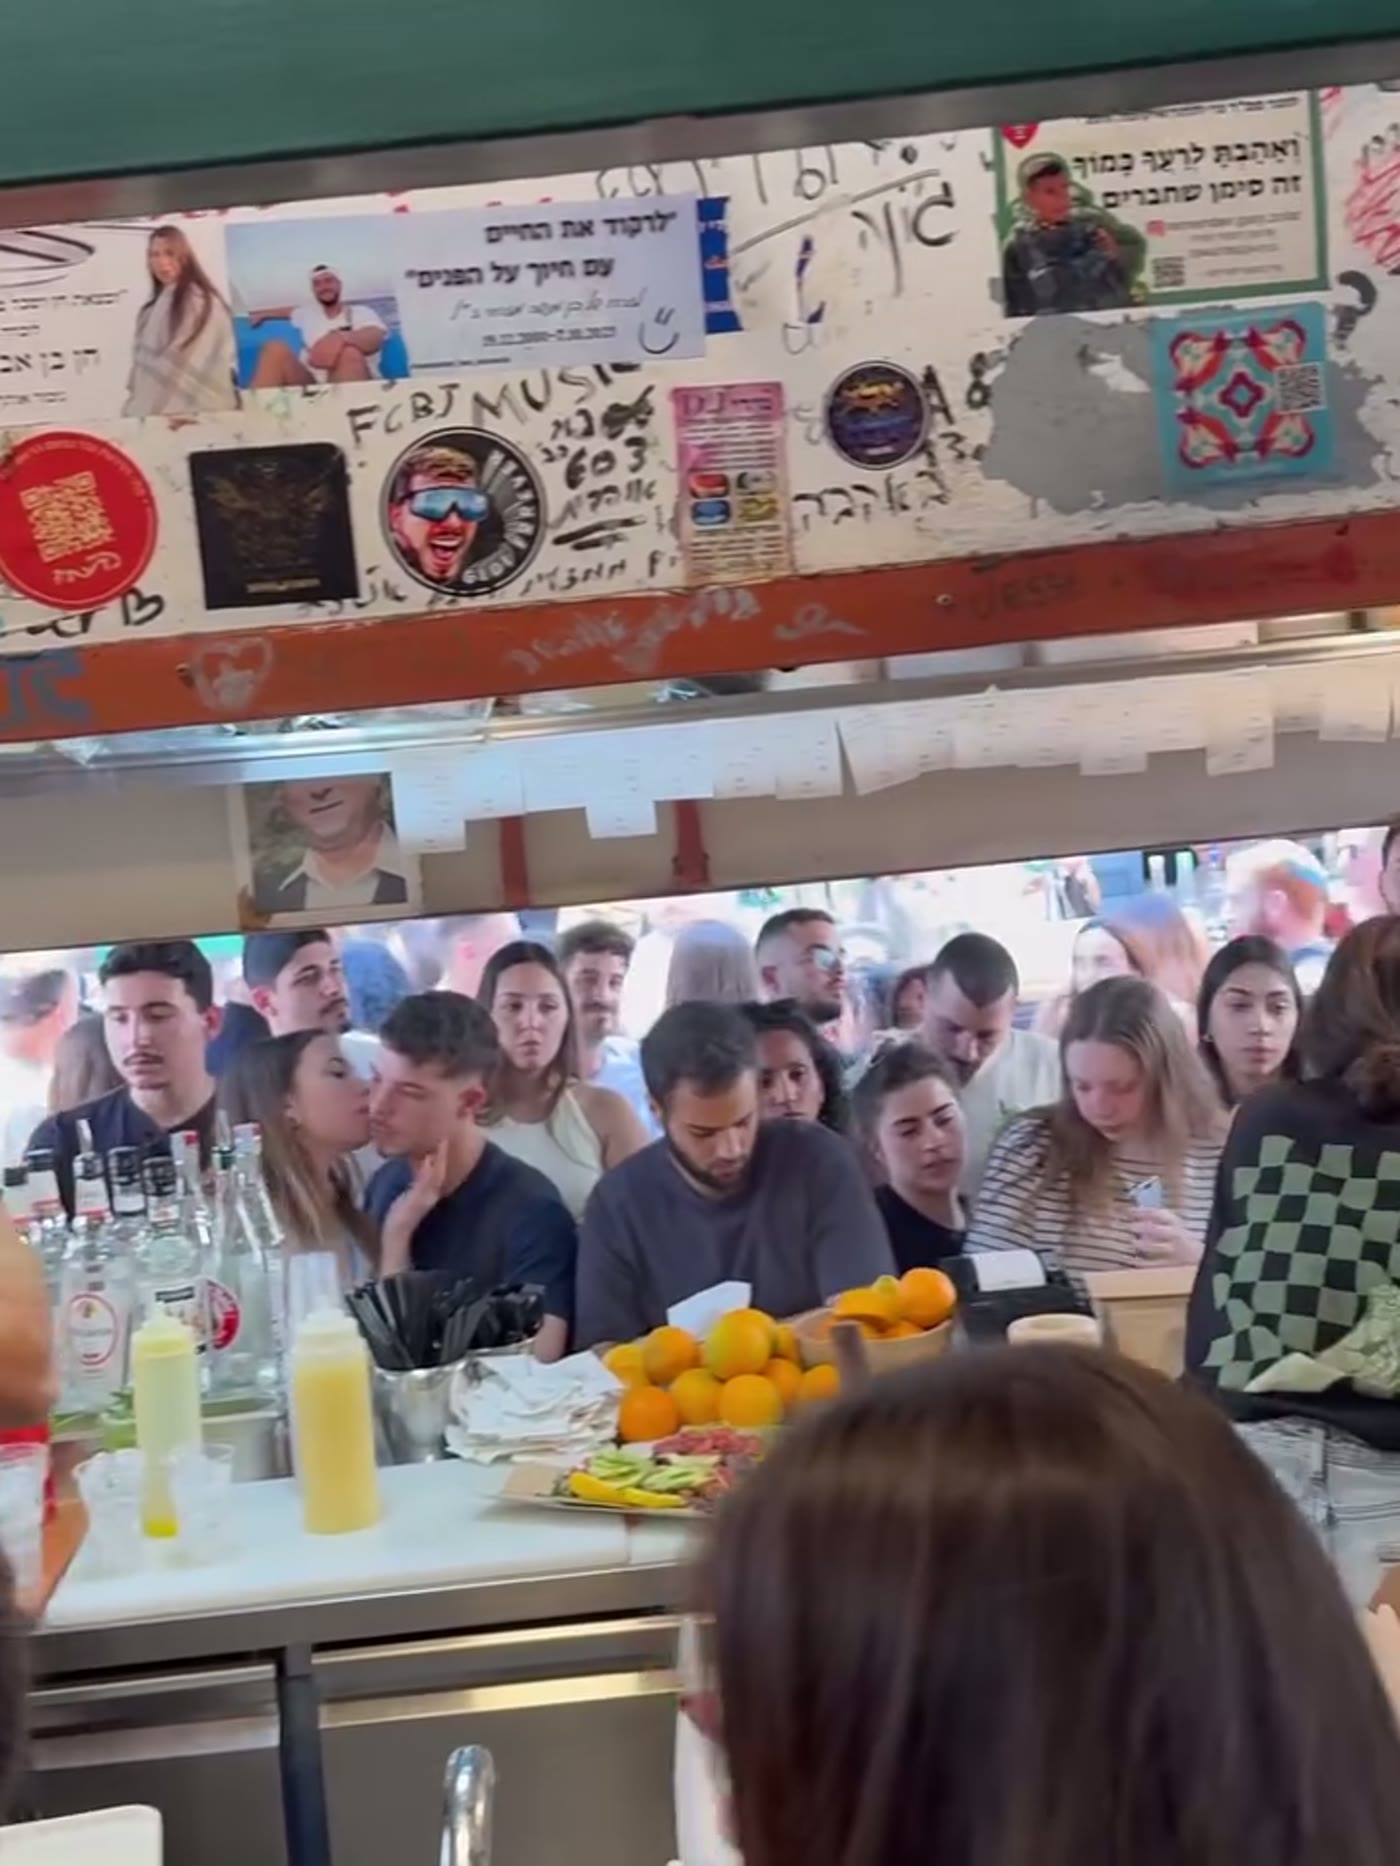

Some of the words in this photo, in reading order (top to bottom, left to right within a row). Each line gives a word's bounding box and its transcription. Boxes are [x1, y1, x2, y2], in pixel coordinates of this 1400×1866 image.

[1209, 178, 1265, 203] סימן
[1271, 175, 1302, 195] זה
[485, 221, 552, 243] החיים
[560, 219, 595, 239] את
[490, 261, 520, 284] על
[526, 259, 576, 287] חיוך
[582, 257, 615, 278] עם
